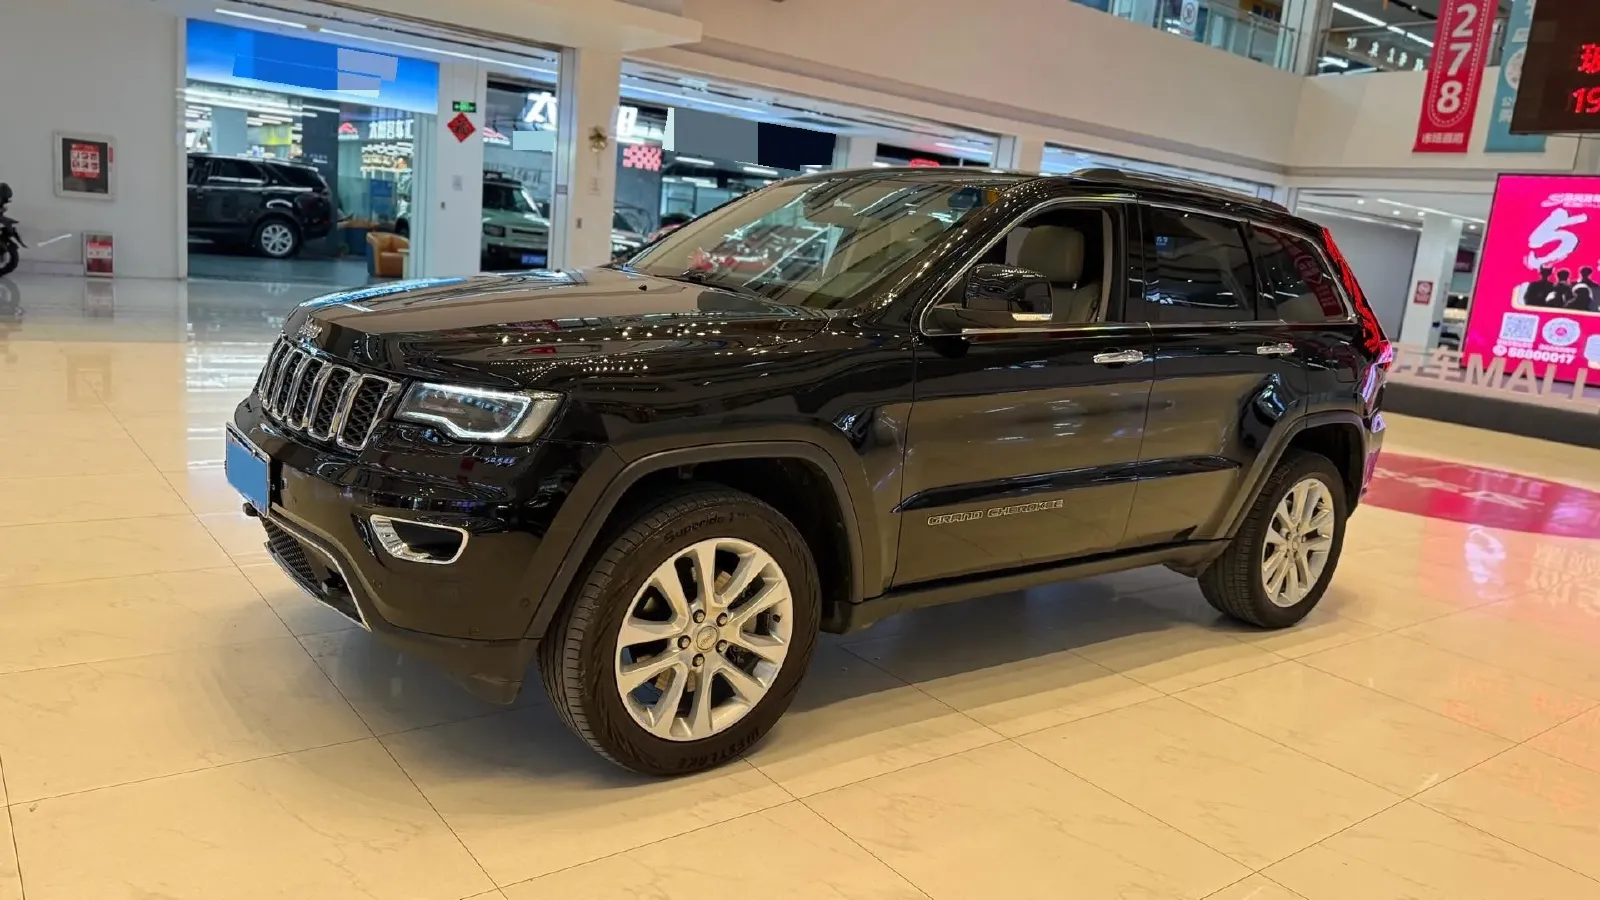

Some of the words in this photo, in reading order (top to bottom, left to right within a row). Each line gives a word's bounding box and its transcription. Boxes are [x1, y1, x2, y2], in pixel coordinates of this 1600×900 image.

[1436, 2, 1478, 115] 278
[927, 510, 984, 526] GRAND
[987, 499, 1064, 518] CHEROKEE
